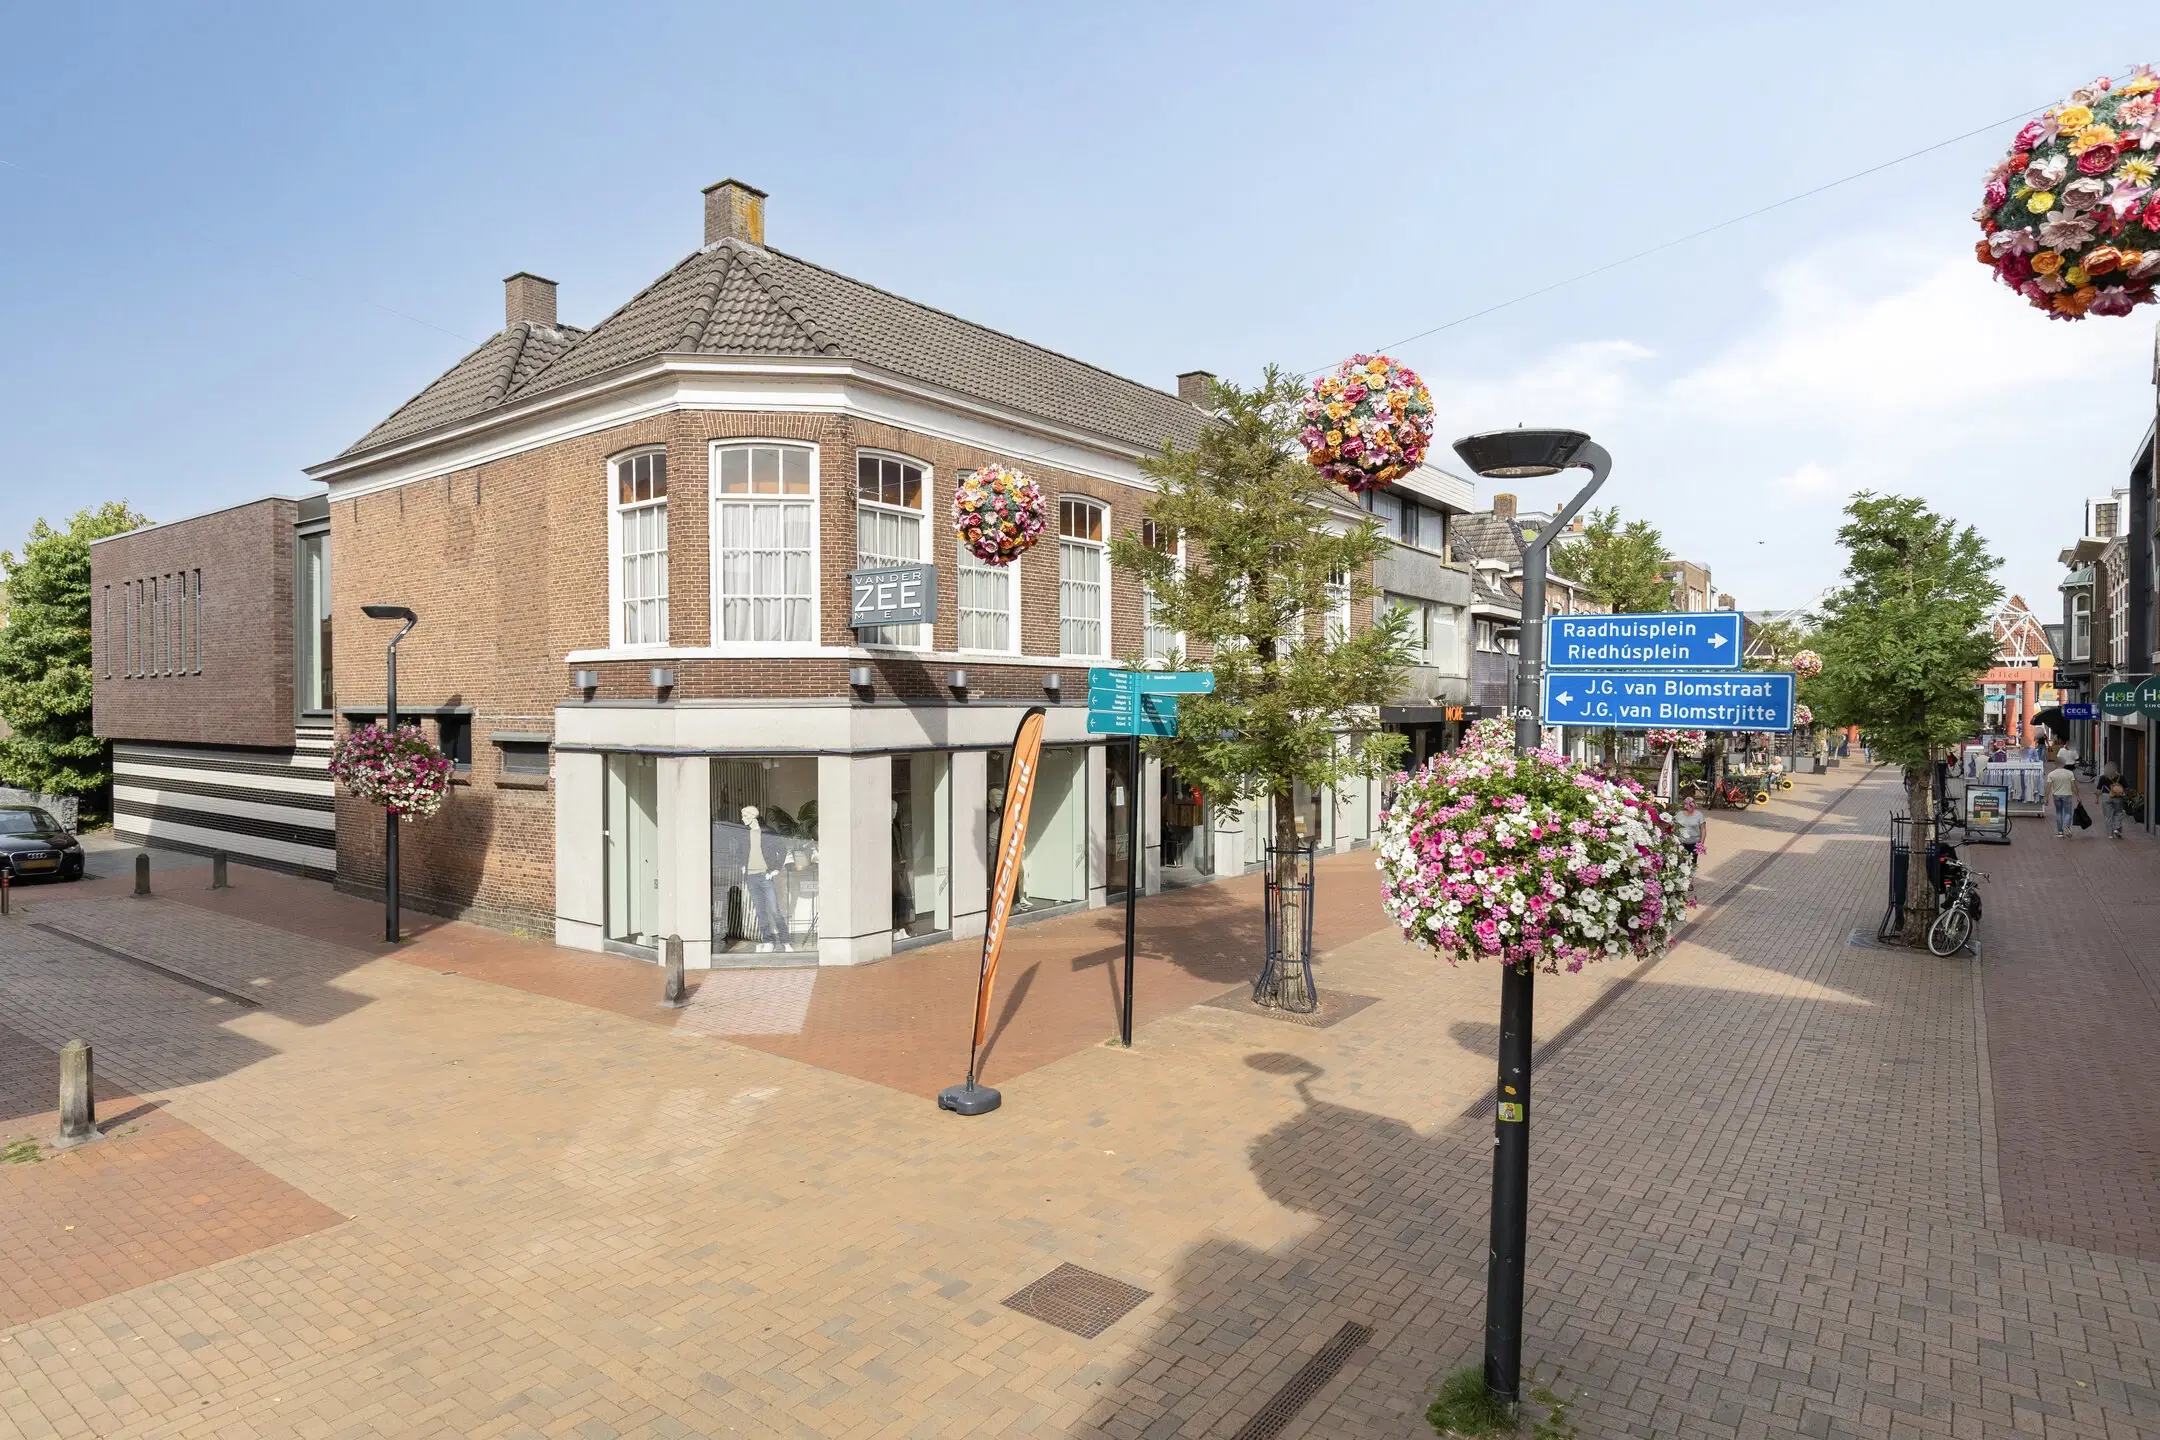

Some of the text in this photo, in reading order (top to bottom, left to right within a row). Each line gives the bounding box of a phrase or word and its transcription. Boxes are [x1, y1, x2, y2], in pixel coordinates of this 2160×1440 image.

[855, 571, 922, 585] VAN DER
[854, 580, 922, 612] ZEE
[854, 608, 922, 620] MEN
[1563, 621, 1697, 640] Raadhuisplein
[1568, 644, 1690, 662] Riedhúsplein
[1584, 679, 1773, 698] J.G. van Blomstraat
[1445, 706, 1464, 721] MORE
[1579, 701, 1777, 725] J.G. van Blomstrjitte
